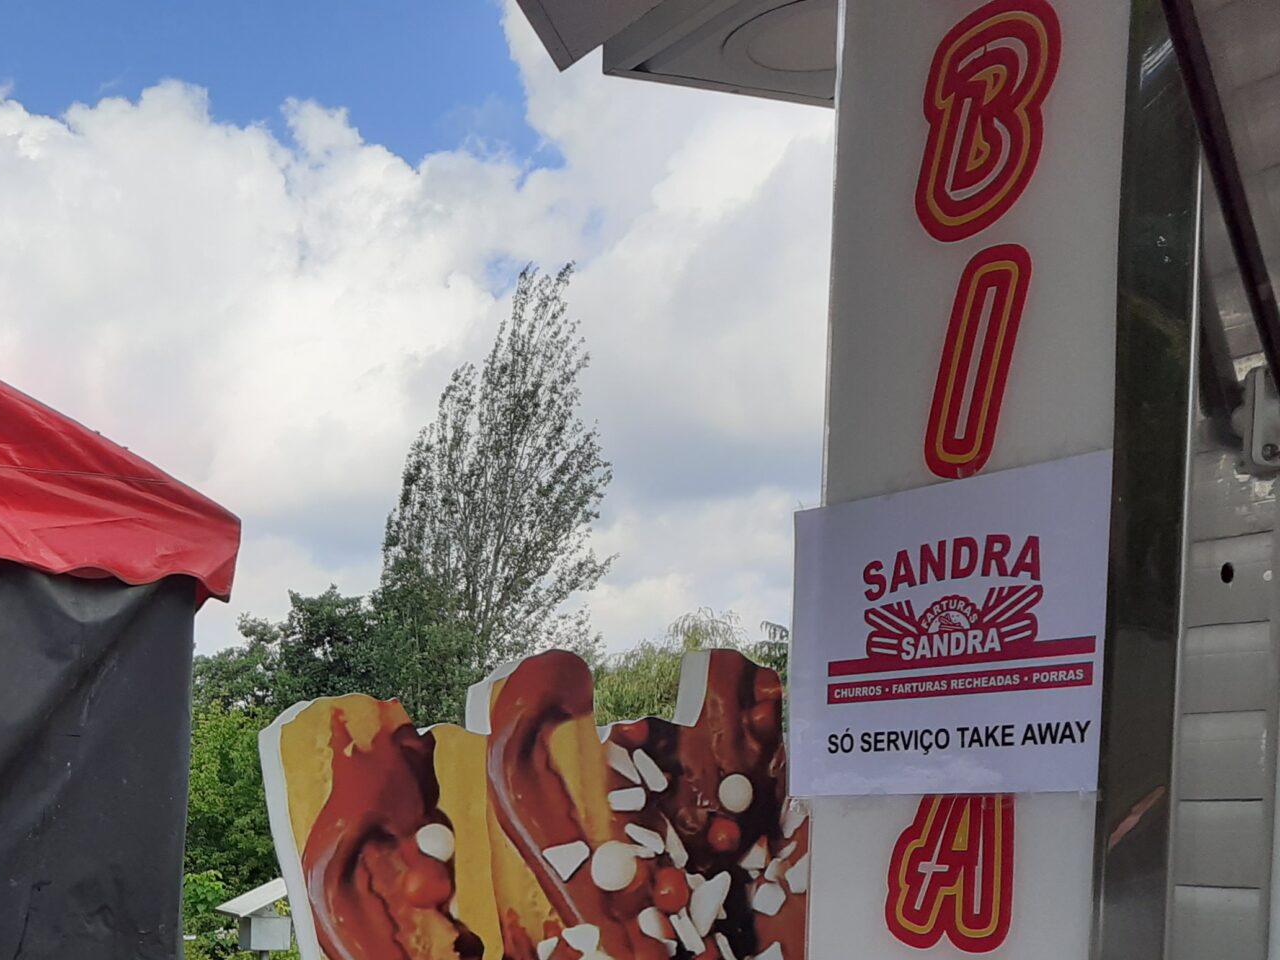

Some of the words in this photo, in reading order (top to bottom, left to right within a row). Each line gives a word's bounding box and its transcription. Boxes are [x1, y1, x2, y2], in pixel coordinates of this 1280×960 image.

[862, 534, 1042, 602] SANDRA
[920, 599, 979, 630] FARTURAS
[901, 627, 1002, 660] SANDRA
[833, 685, 882, 699] CHURROS
[891, 679, 948, 694] FARTURAS
[950, 674, 1020, 690] RECHEADAS
[1032, 669, 1084, 683] PORRAS
[827, 728, 854, 754] SÓ
[860, 728, 950, 755] SERVIÇO
[956, 724, 1015, 748] TAKE
[1021, 720, 1091, 746] AWAY
